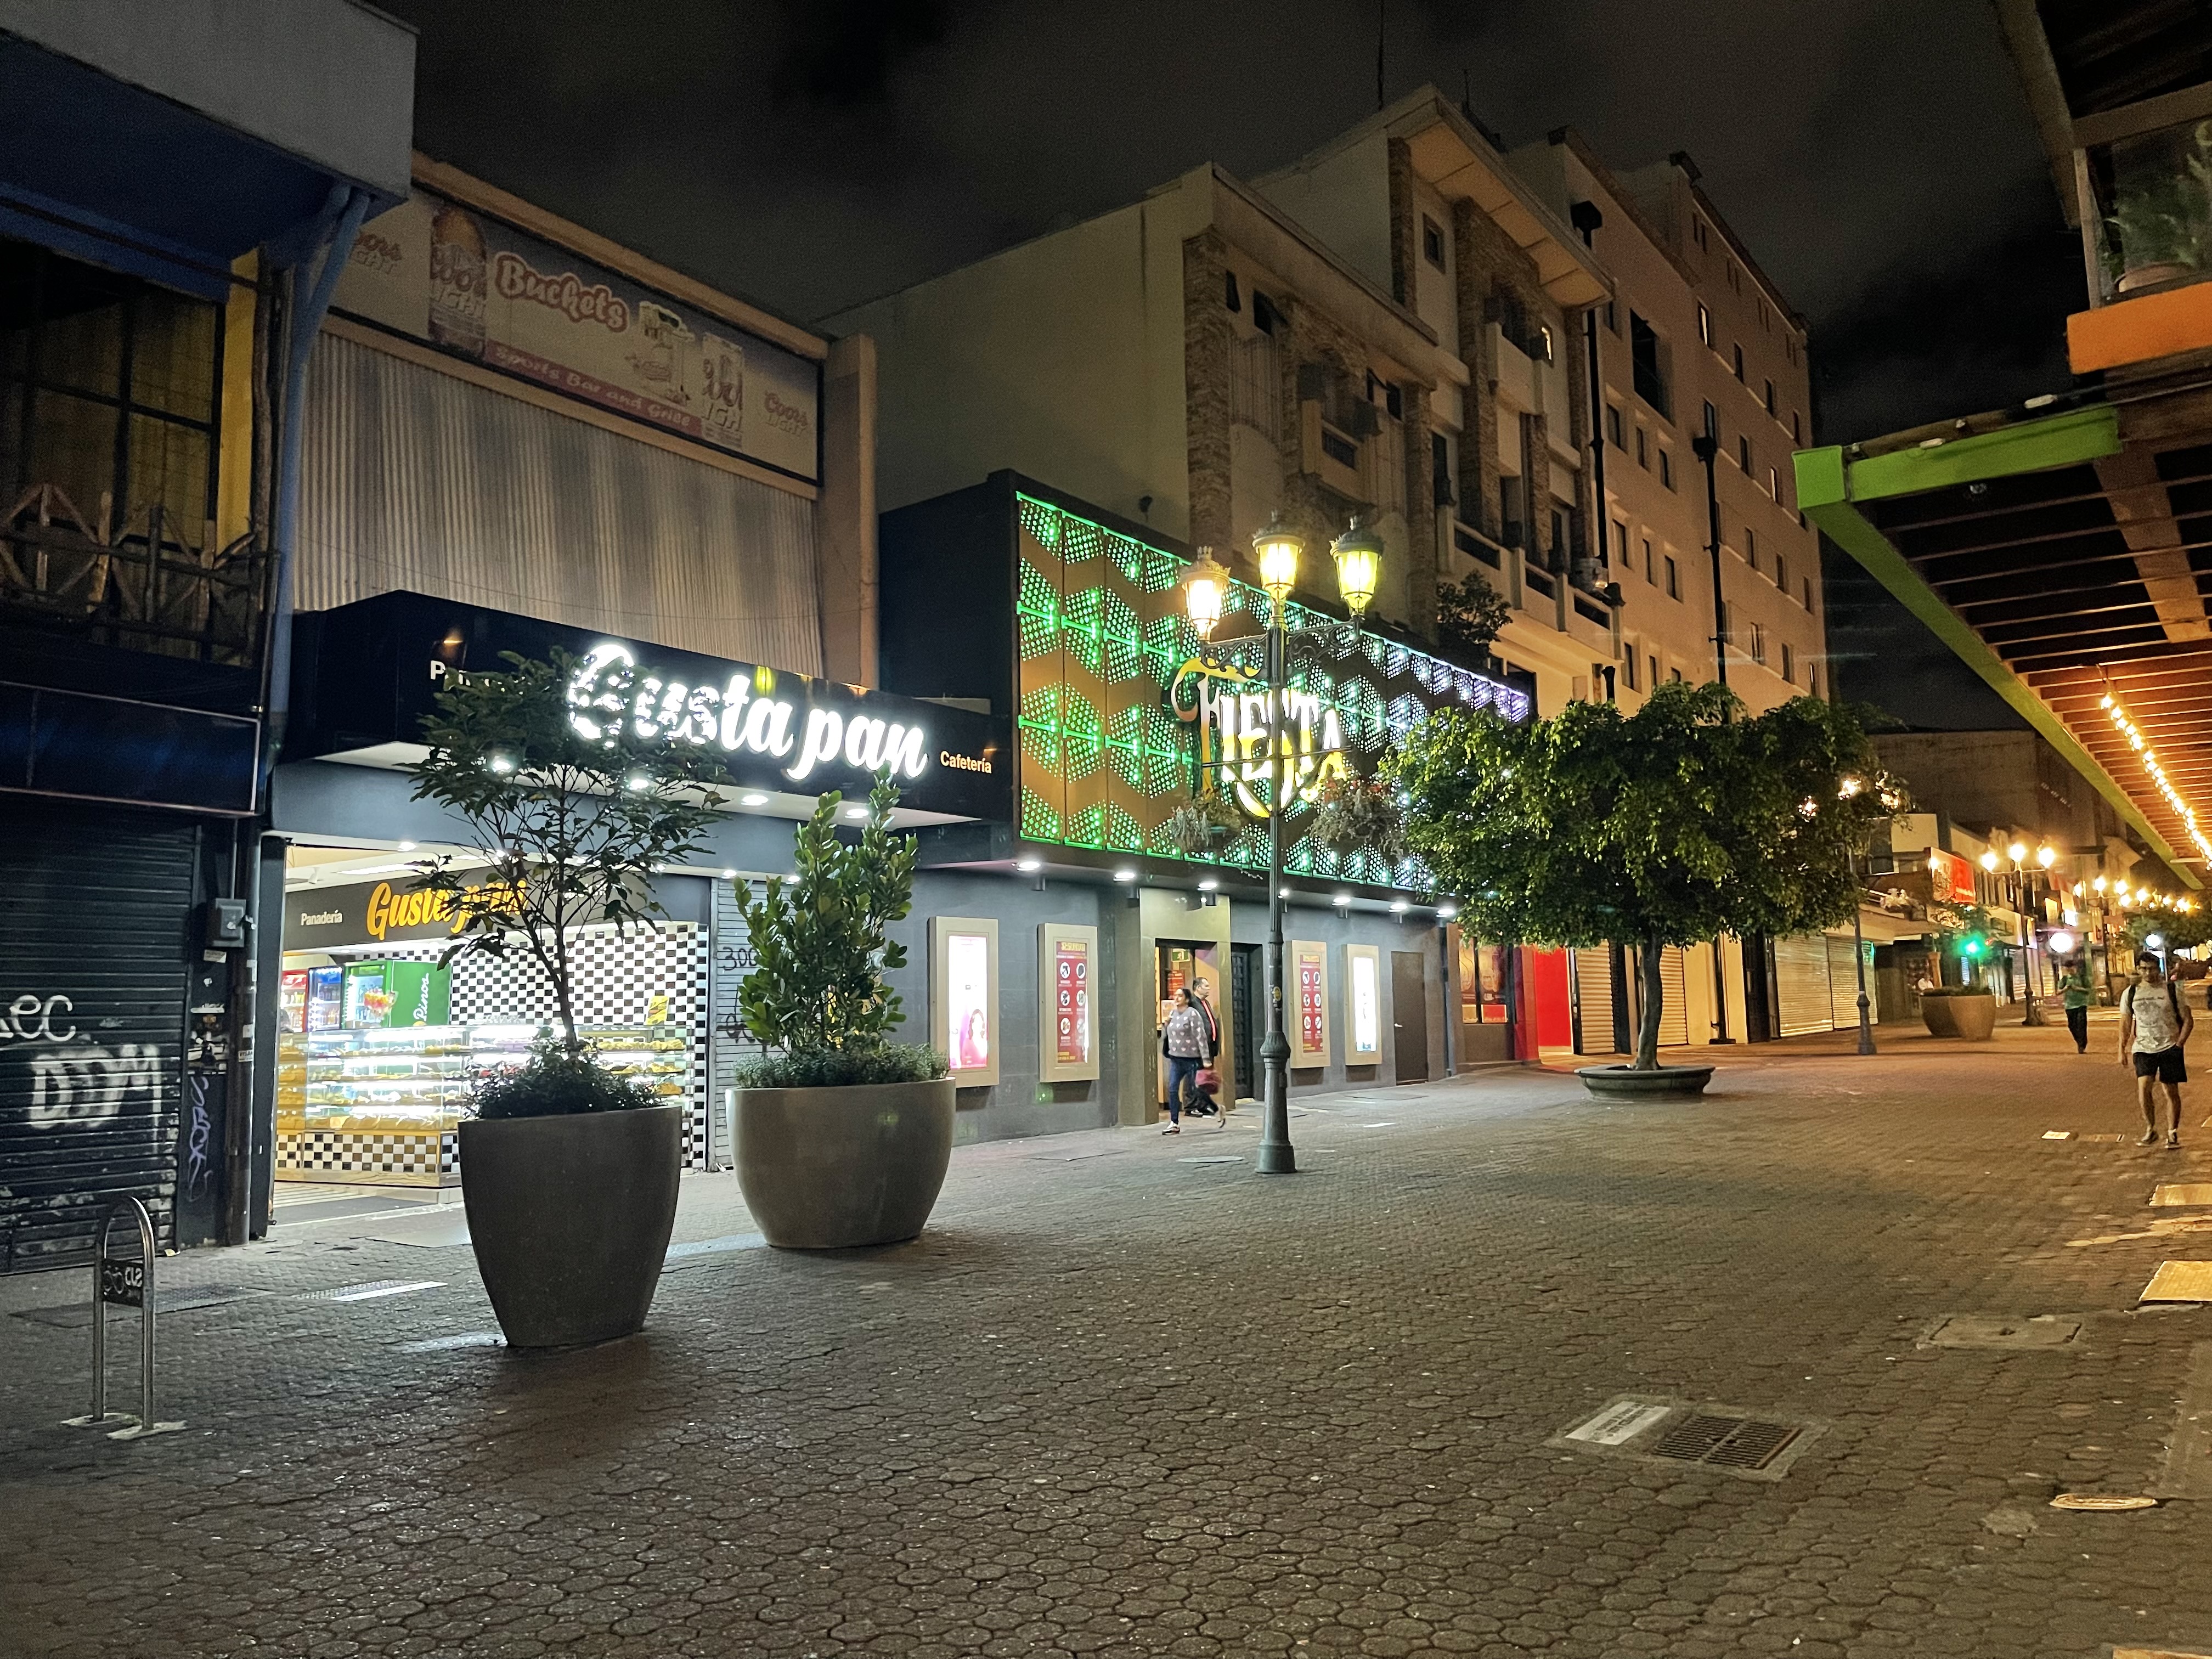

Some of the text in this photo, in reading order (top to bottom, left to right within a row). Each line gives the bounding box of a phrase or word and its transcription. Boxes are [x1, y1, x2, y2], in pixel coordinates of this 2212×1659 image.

[495, 252, 628, 332] Buckets
[496, 346, 561, 380] Sports
[566, 373, 602, 393] Bar
[606, 391, 642, 409] and
[765, 390, 808, 427] Coors
[567, 644, 928, 780] Gusta pan
[1171, 657, 1347, 819] FIESTA
[940, 751, 992, 774] Cafetería
[301, 909, 343, 926] Panadería
[366, 882, 454, 940] Gusta
[413, 972, 429, 1022] Pinos
